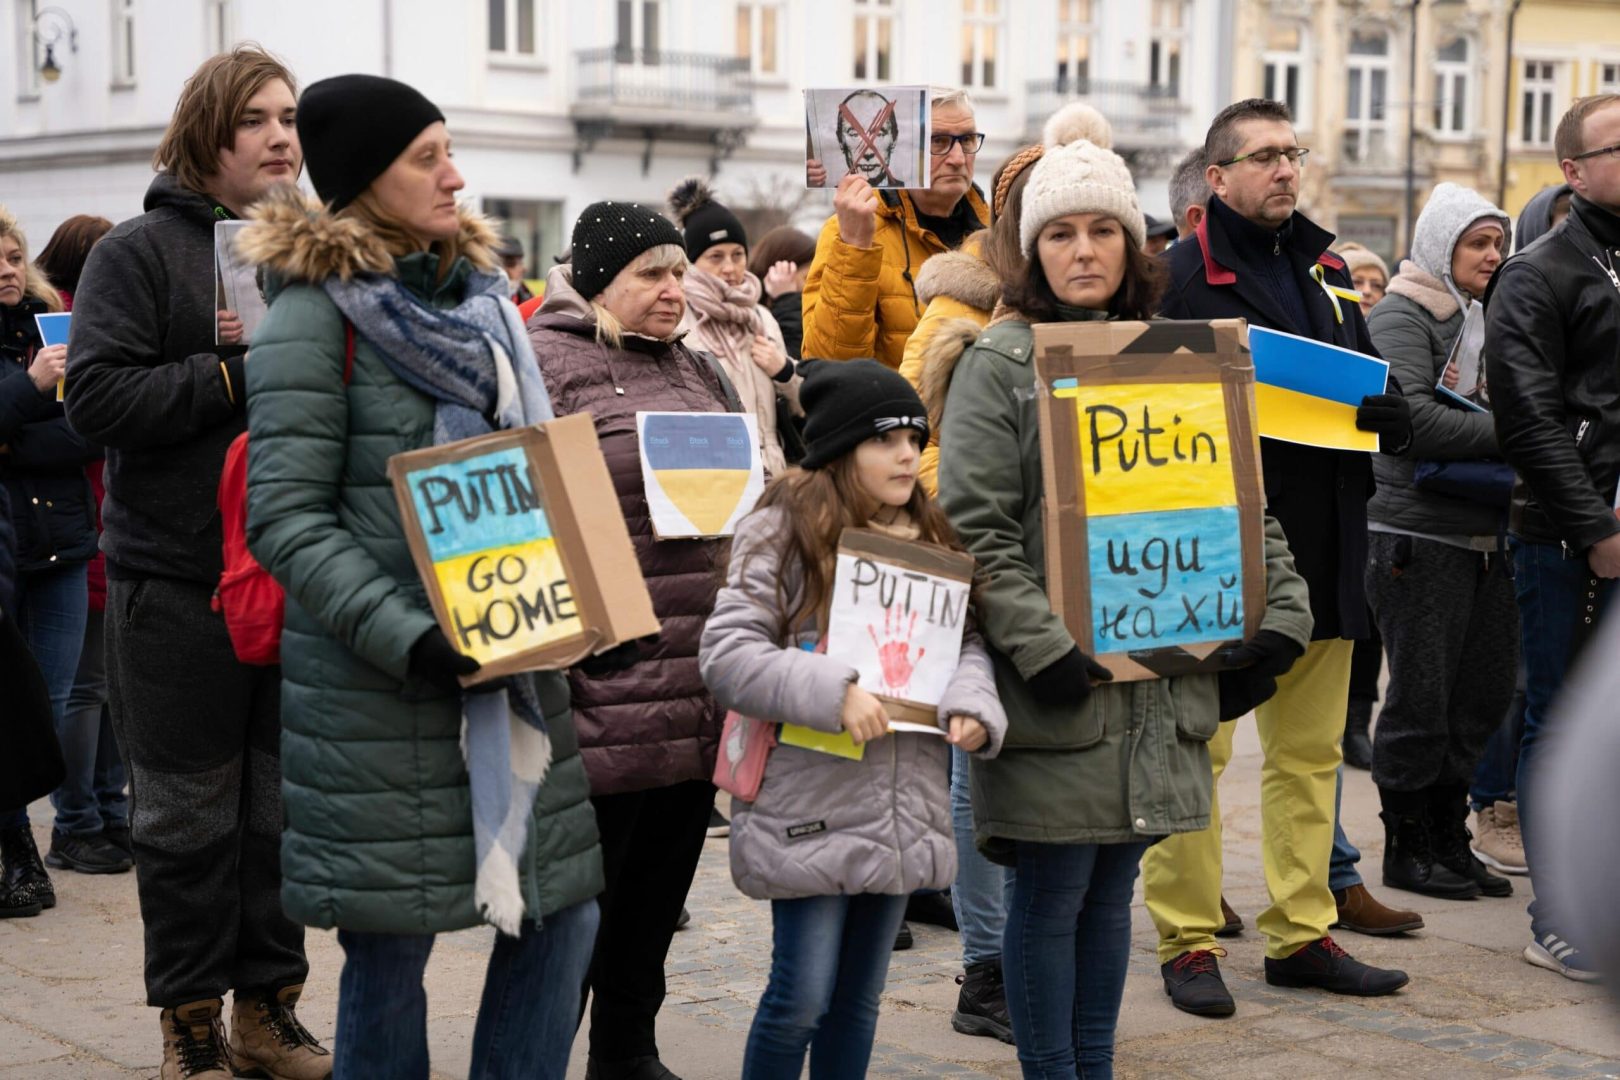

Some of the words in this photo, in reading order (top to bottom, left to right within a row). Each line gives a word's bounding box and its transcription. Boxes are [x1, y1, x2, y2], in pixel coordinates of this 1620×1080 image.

[1085, 404, 1217, 476] Putin
[417, 463, 541, 535] PUTIN
[467, 554, 527, 593] GO
[850, 557, 969, 630] PUTIN
[453, 580, 579, 649] HOME
